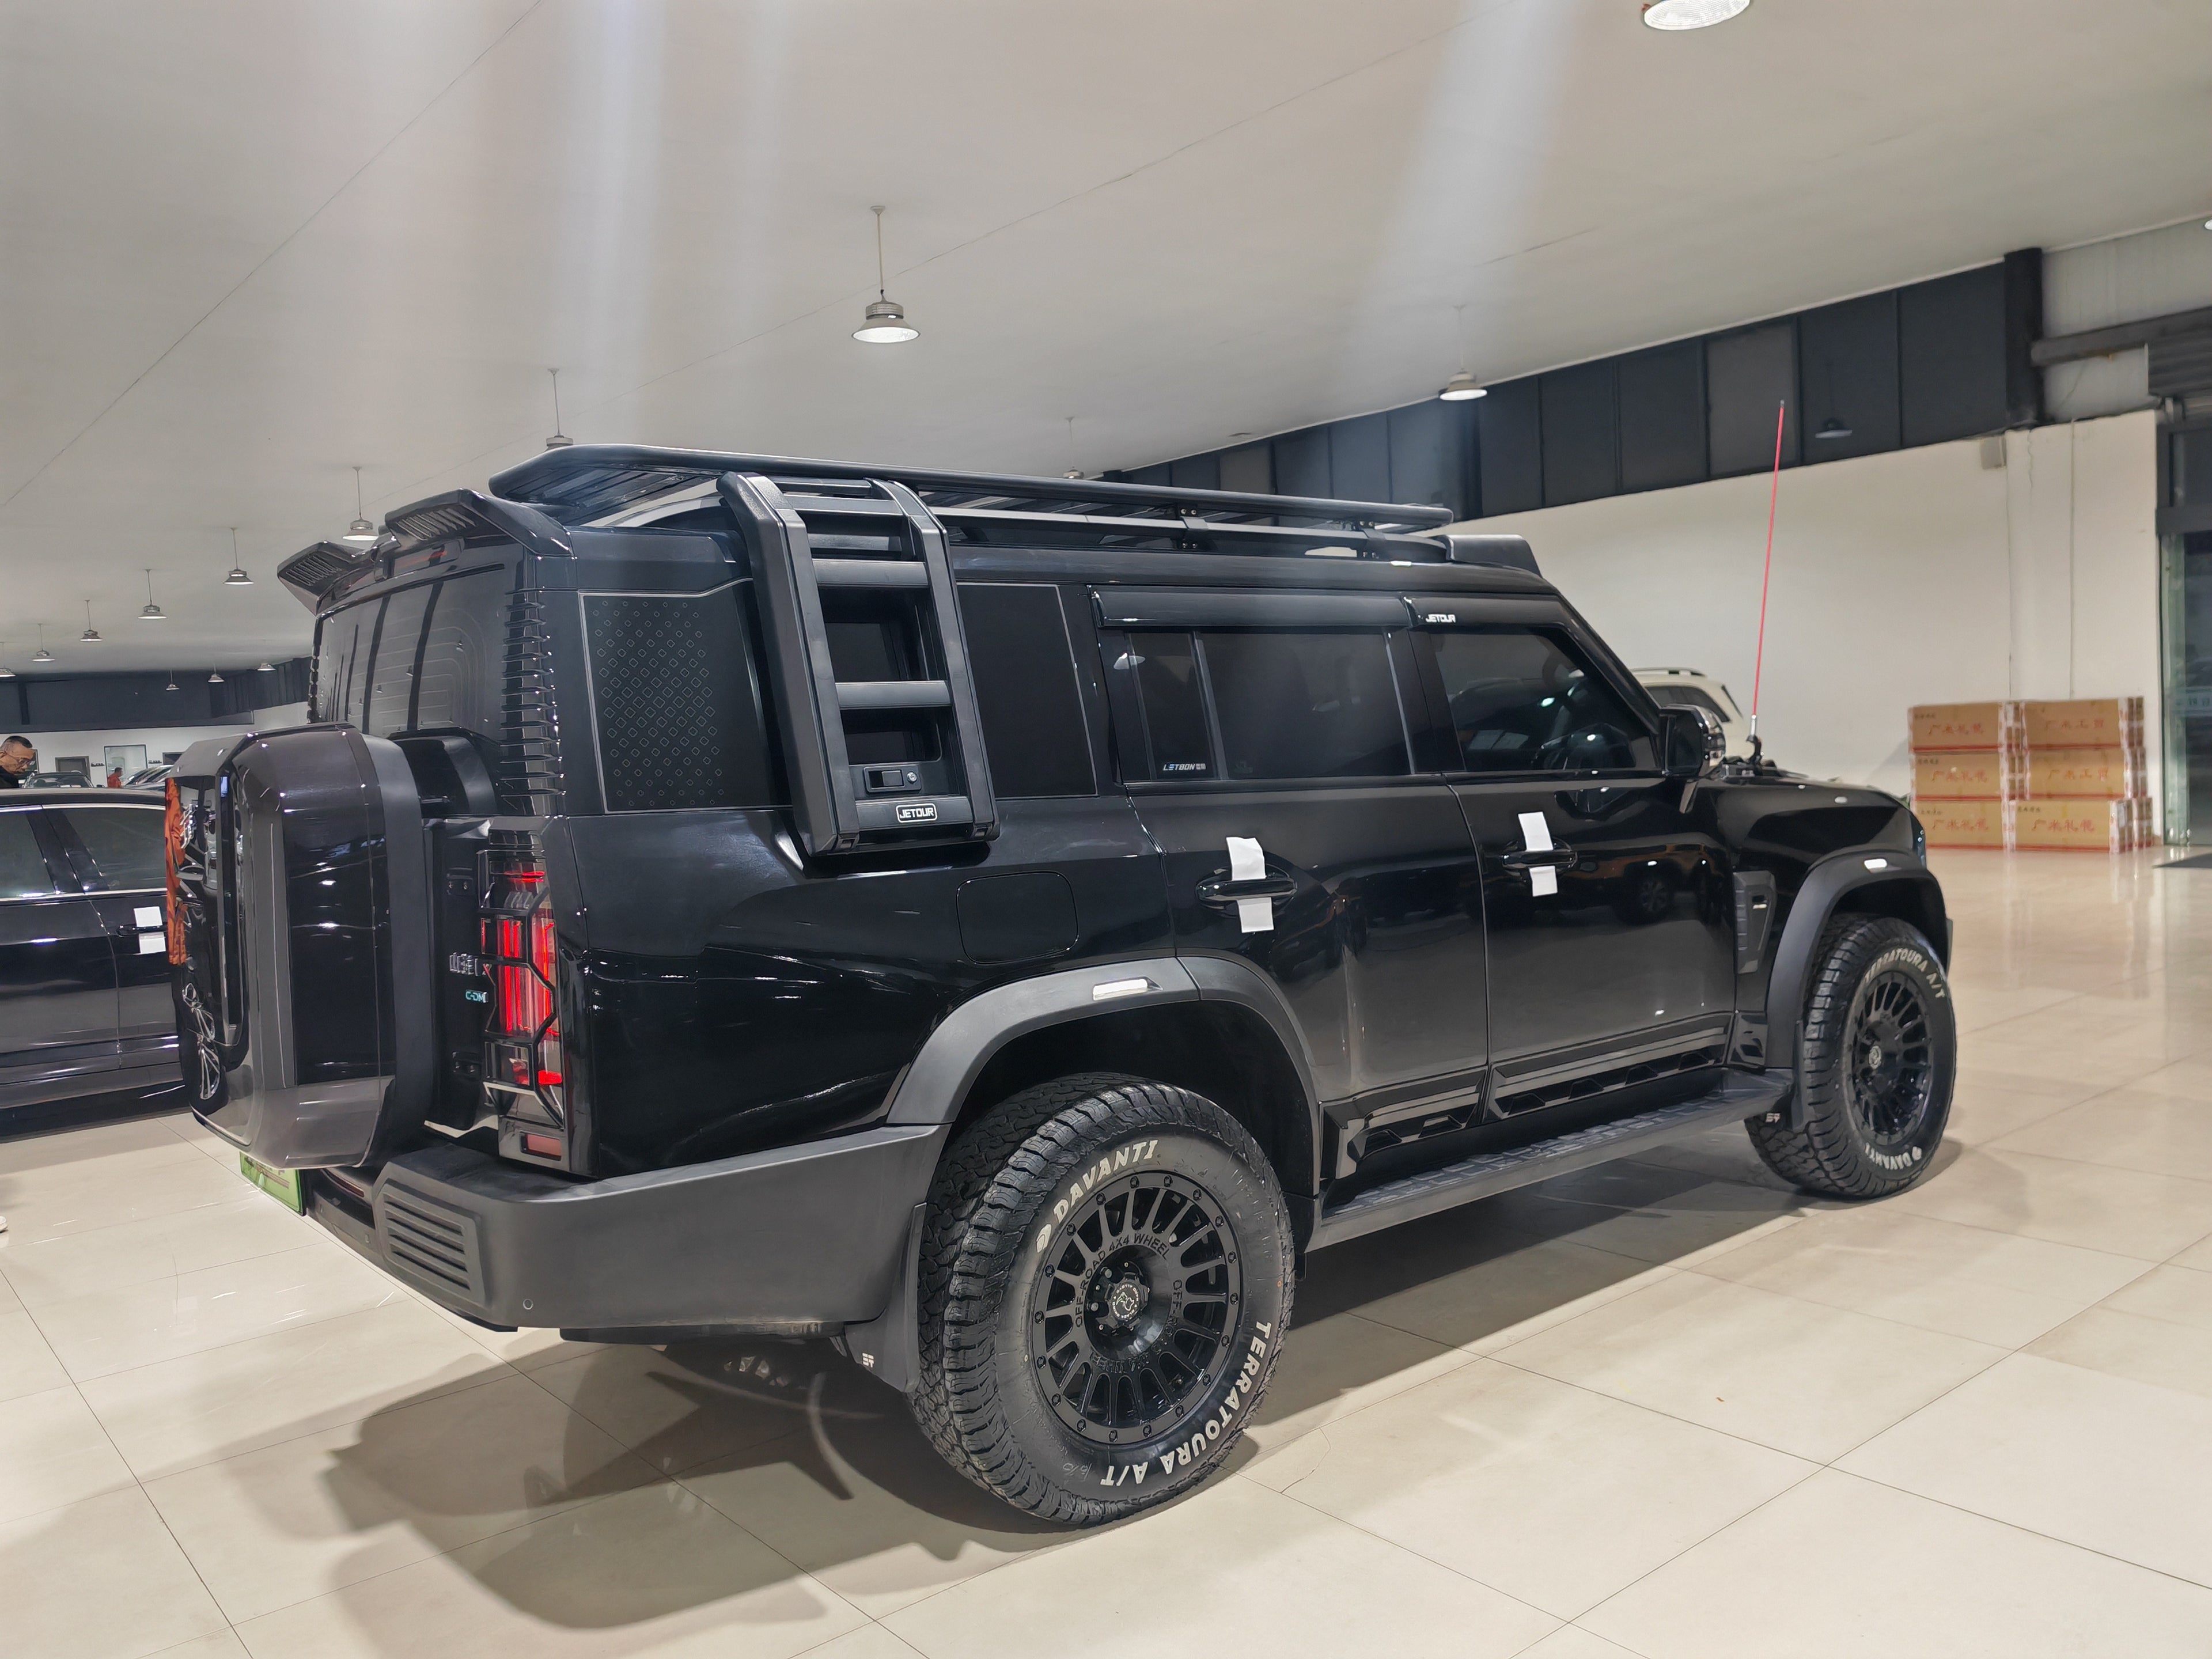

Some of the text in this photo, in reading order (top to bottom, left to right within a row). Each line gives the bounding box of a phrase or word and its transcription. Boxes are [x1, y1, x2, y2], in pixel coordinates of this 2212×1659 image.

[1425, 613, 1456, 623] JETOUR
[899, 807, 934, 819] JETOUR
[1053, 1139, 1158, 1224] DAVANTI
[1075, 1233, 1170, 1328] OFF-ROAD 4X4 WHEEL
[1101, 1321, 1271, 1486] TERRATOURA A/T
